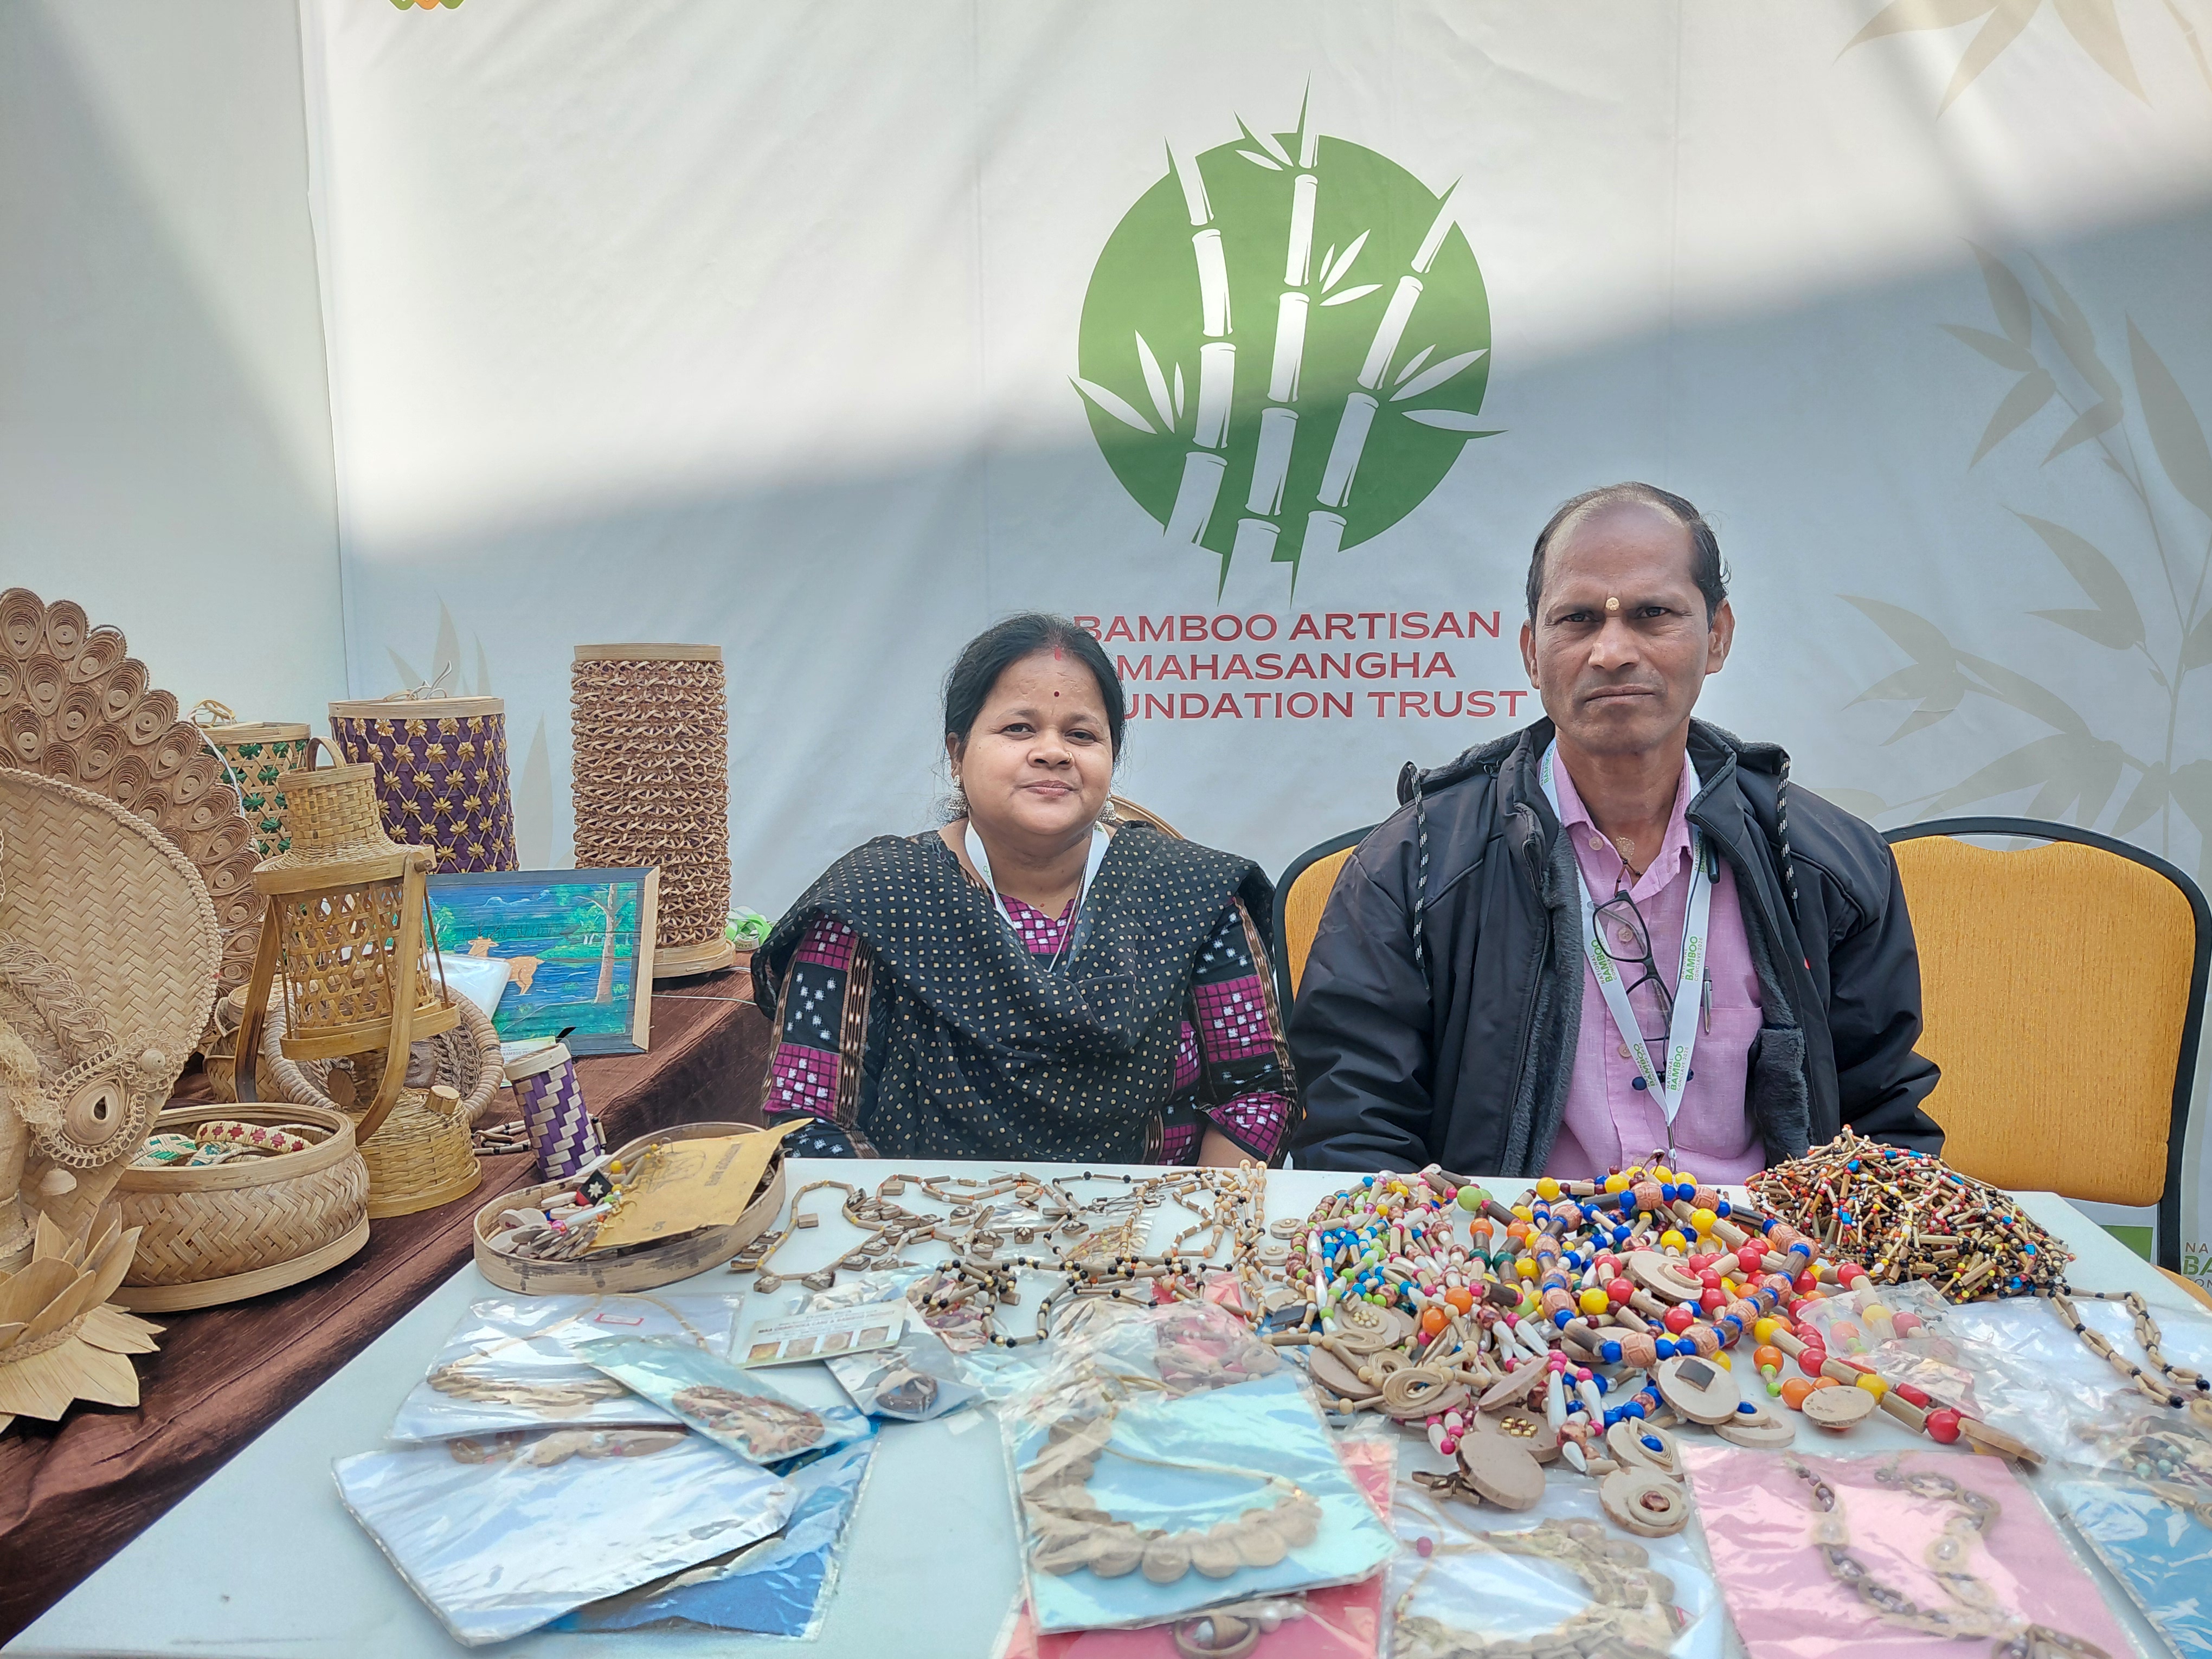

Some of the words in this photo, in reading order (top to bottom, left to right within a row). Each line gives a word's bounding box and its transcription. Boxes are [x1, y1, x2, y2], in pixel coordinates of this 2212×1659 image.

[1074, 614, 1278, 642] BAMBOO
[1289, 611, 1500, 640] ARTISAN
[1117, 652, 1456, 680] MAHASANGHA
[1124, 692, 1354, 719] UNDATION
[1367, 690, 1528, 717] TRUST
[1590, 954, 1606, 985] NATIONAL
[1591, 938, 1613, 982] BAMBOO
[1685, 936, 1698, 981] BAMBOO
[1634, 1043, 1655, 1086] BAMBOO
[1670, 1045, 1684, 1091] BAMBOO
